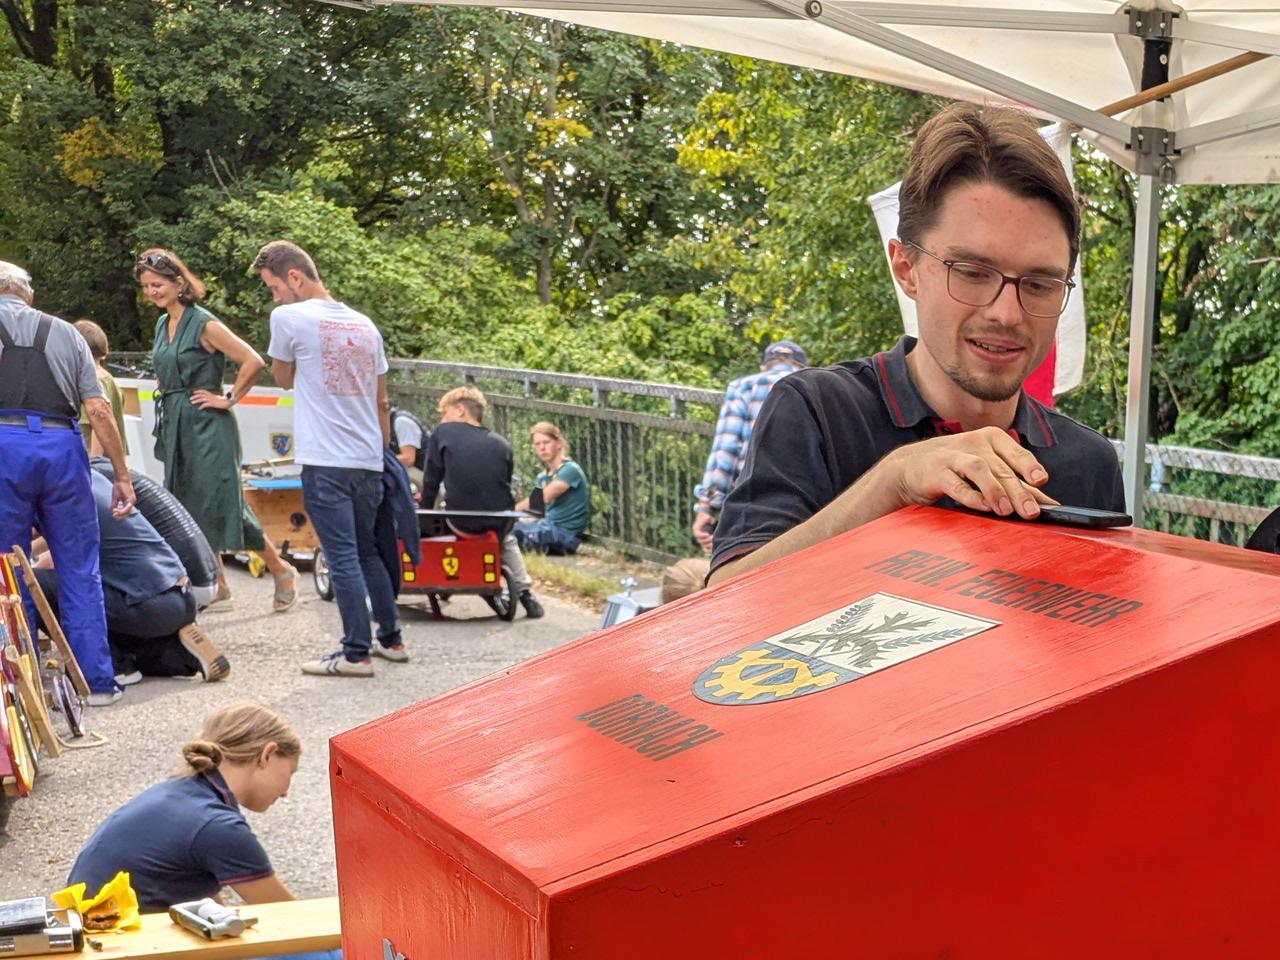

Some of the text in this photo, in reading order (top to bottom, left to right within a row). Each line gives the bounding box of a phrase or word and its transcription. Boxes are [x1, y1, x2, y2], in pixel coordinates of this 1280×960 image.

[864, 549, 1144, 629] FREIW. FEUERWEHR
[574, 693, 725, 763] DORNACH
